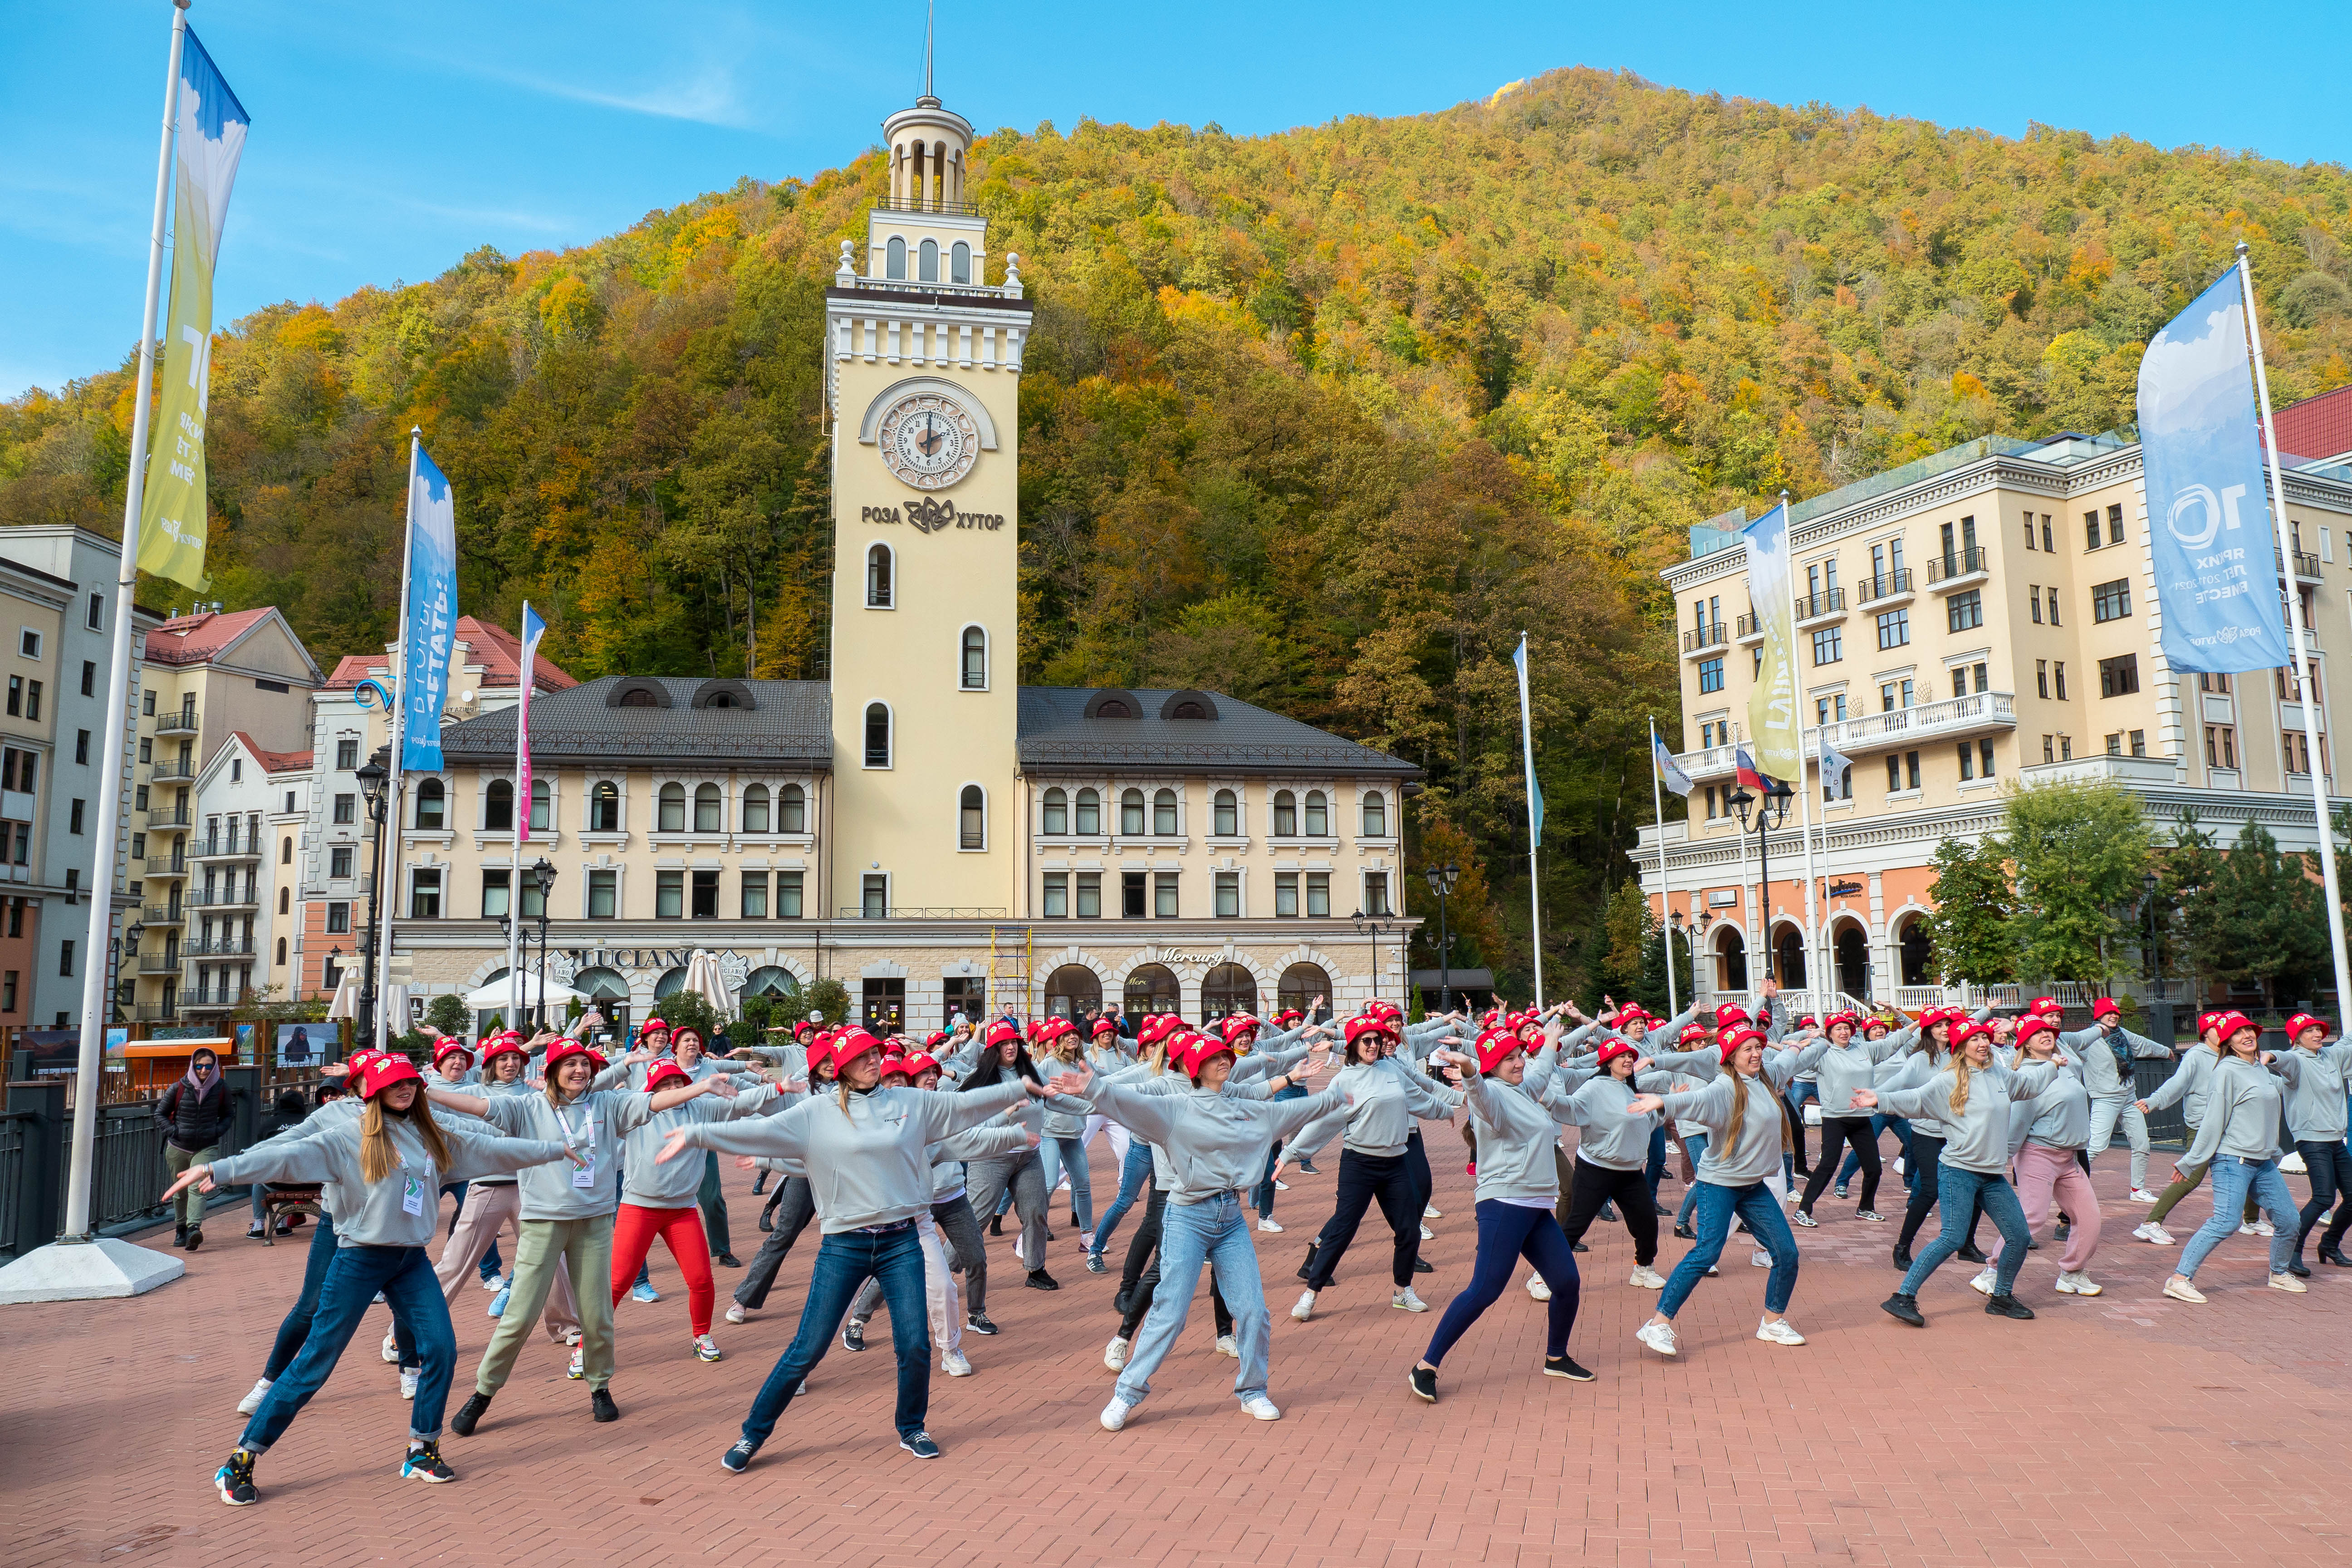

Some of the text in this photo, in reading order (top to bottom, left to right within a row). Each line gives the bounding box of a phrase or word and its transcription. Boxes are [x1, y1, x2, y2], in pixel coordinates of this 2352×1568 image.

[862, 506, 1004, 530] РОЗА ХУТОР
[414, 696, 425, 714] В
[1153, 947, 1227, 968] Mercury
